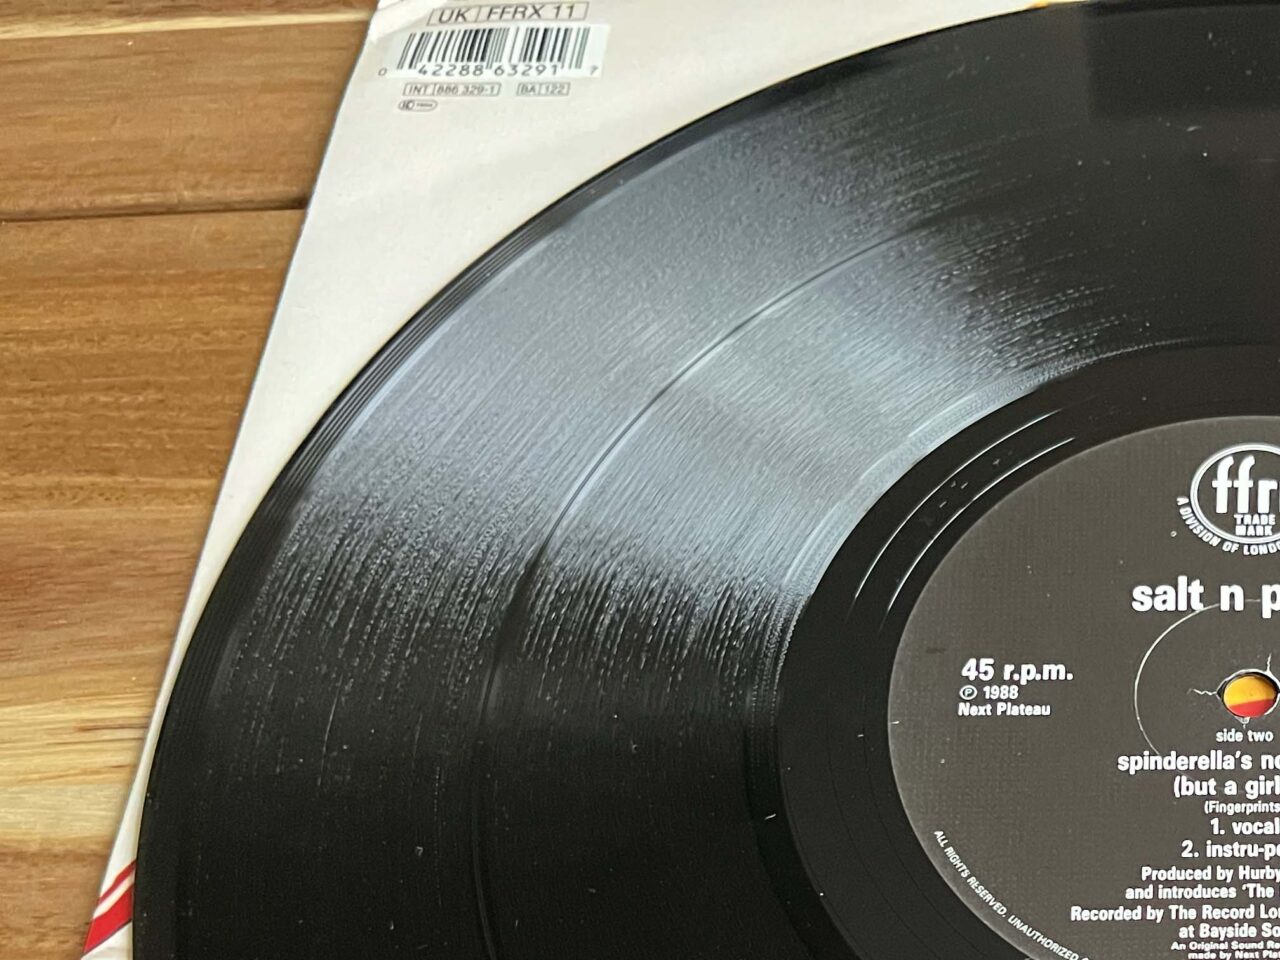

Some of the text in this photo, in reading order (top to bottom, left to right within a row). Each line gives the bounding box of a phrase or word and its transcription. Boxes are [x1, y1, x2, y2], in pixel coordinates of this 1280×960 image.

[438, 4, 576, 24] UK FFRX 11
[417, 64, 484, 77] 42288
[494, 64, 558, 76] 63291
[1176, 496, 1189, 506] A
[1179, 507, 1222, 547] DIVISION
[1233, 514, 1276, 525] TRADE
[1235, 525, 1273, 536] MARK
[1222, 541, 1239, 553] OF
[1131, 575, 1204, 611] salt
[1220, 584, 1244, 611] n
[961, 658, 1073, 685] 45 r.p.m.
[983, 685, 1019, 700] 1988
[958, 702, 1051, 716] Next Plateau
[1216, 729, 1274, 743] side two
[1117, 749, 1253, 775] spinderella's
[1173, 776, 1217, 798] (but
[1224, 779, 1238, 795] a
[1245, 775, 1280, 799] girl
[1210, 817, 1280, 835] 1. vocal
[934, 830, 949, 848] ALL
[944, 846, 971, 878] RIGHTS
[1181, 840, 1199, 858] 2.
[1141, 865, 1212, 882] Produced
[1216, 866, 1234, 884] by
[1125, 885, 1154, 900] and
[1158, 883, 1237, 899] introduces
[1070, 905, 1142, 922] Recorded
[1146, 905, 1164, 924] by
[1169, 904, 1197, 920] The
[1201, 904, 1255, 920] Record
[1179, 923, 1195, 939] at
[1199, 922, 1257, 941] Bayside
[1171, 941, 1186, 950] An
[1189, 941, 1229, 951] Original
[1231, 941, 1263, 950] Sound
[1187, 951, 1217, 959] made
[1219, 951, 1232, 960] by
[1234, 950, 1260, 959] Next
